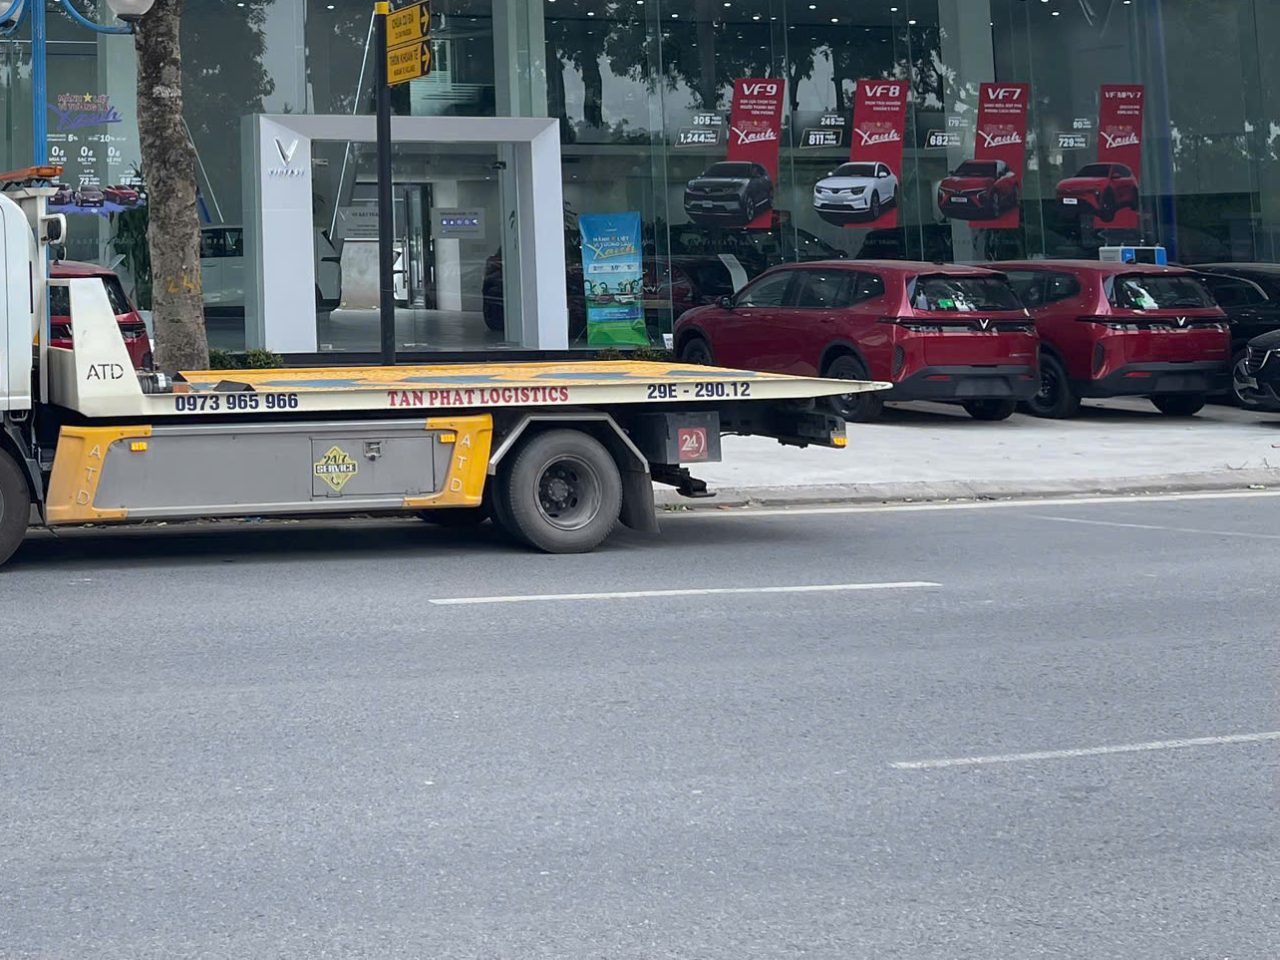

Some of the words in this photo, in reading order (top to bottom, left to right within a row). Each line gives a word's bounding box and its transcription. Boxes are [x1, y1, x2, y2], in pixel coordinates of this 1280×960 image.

[742, 83, 777, 96] VF9
[865, 85, 900, 97] VF8
[987, 88, 1022, 100] VF7
[693, 116, 711, 125] 305
[680, 133, 705, 143] 1,244
[732, 126, 777, 145] Xanh
[854, 128, 901, 146] Xanh
[930, 135, 949, 146] 682
[978, 130, 1022, 148] Xanh
[86, 364, 124, 380] ATD
[388, 391, 424, 407] TAN
[429, 389, 475, 406] PHAT
[479, 386, 569, 404] LOGISTICS
[647, 383, 677, 399] 29E
[695, 382, 751, 398] 290.12
[175, 394, 220, 412] 0973
[226, 393, 259, 410] 965
[265, 392, 298, 409] 966
